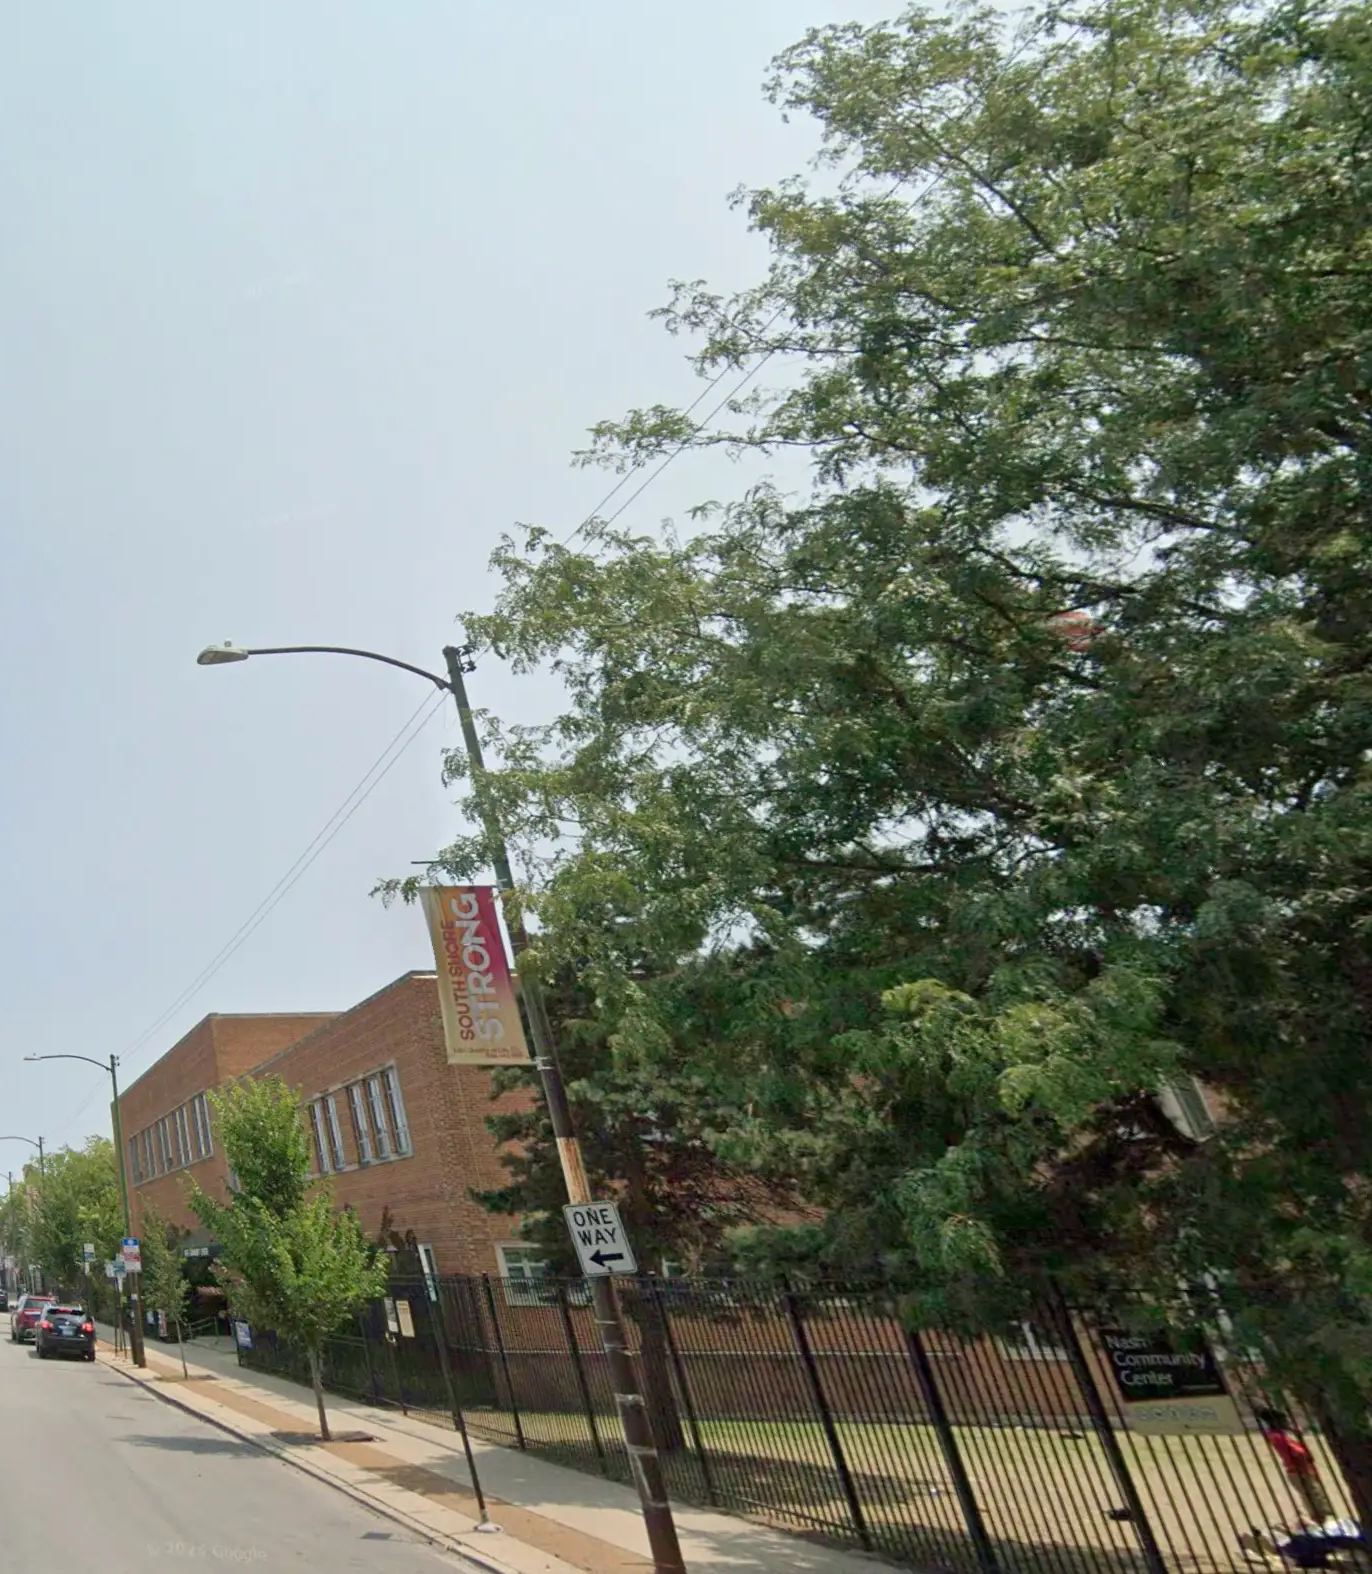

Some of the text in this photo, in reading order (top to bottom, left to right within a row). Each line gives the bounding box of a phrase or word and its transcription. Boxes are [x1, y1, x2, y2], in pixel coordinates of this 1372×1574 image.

[451, 892, 504, 1042] STRONG
[440, 920, 475, 1041] SOUTH SHORE
[573, 1208, 613, 1227] ONE
[577, 1227, 617, 1246] WAY
[1113, 1351, 1206, 1369] Community
[1120, 1370, 1173, 1385] Center
